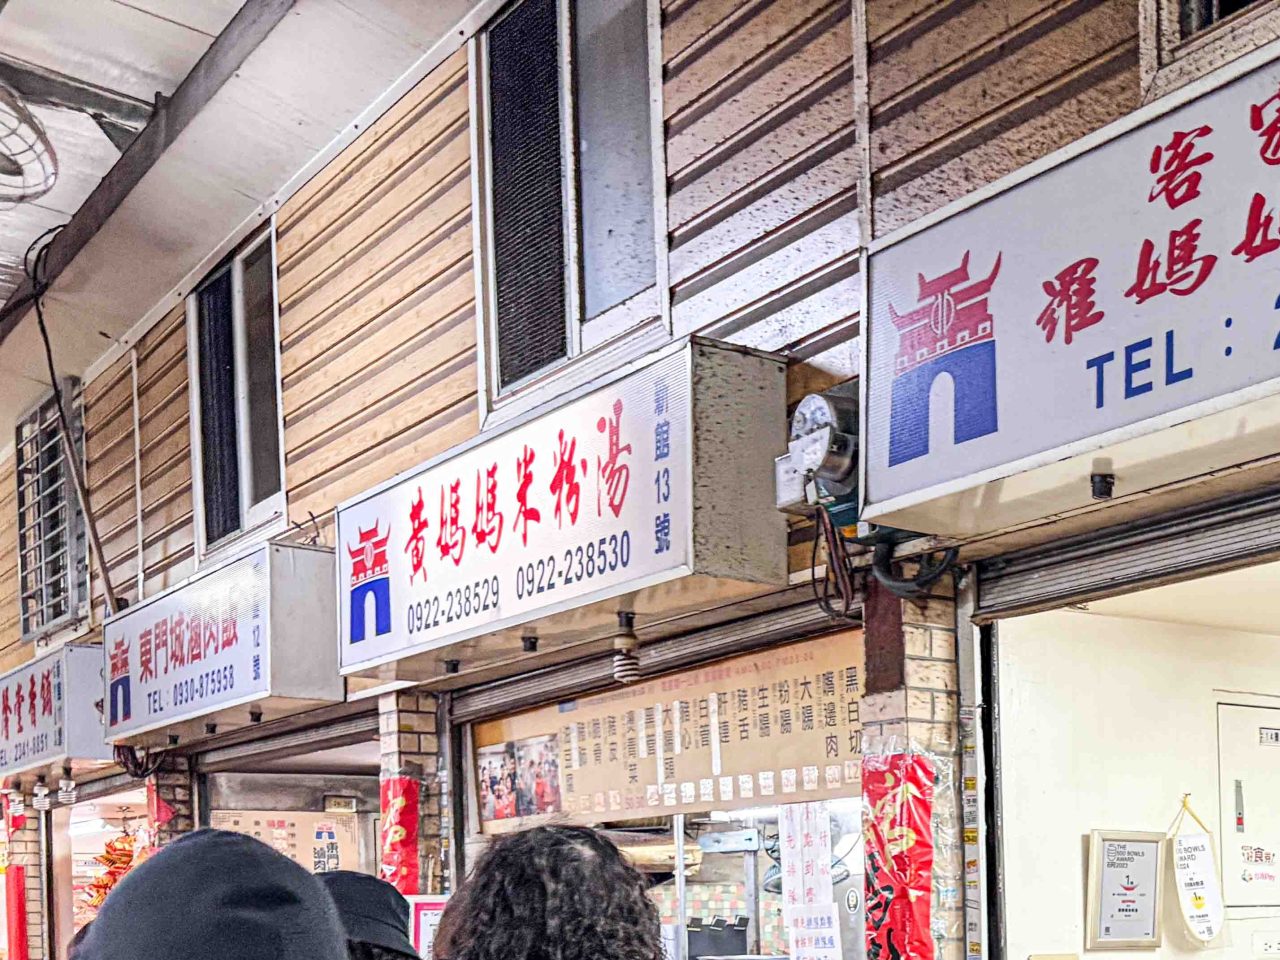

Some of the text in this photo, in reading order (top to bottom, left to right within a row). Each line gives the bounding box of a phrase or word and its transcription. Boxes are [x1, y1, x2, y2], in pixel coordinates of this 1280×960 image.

[404, 399, 632, 586] 黃媽媽米粉湯
[408, 530, 632, 635] 0922-238529 0922-238530
[173, 664, 235, 707] 0930-875958
